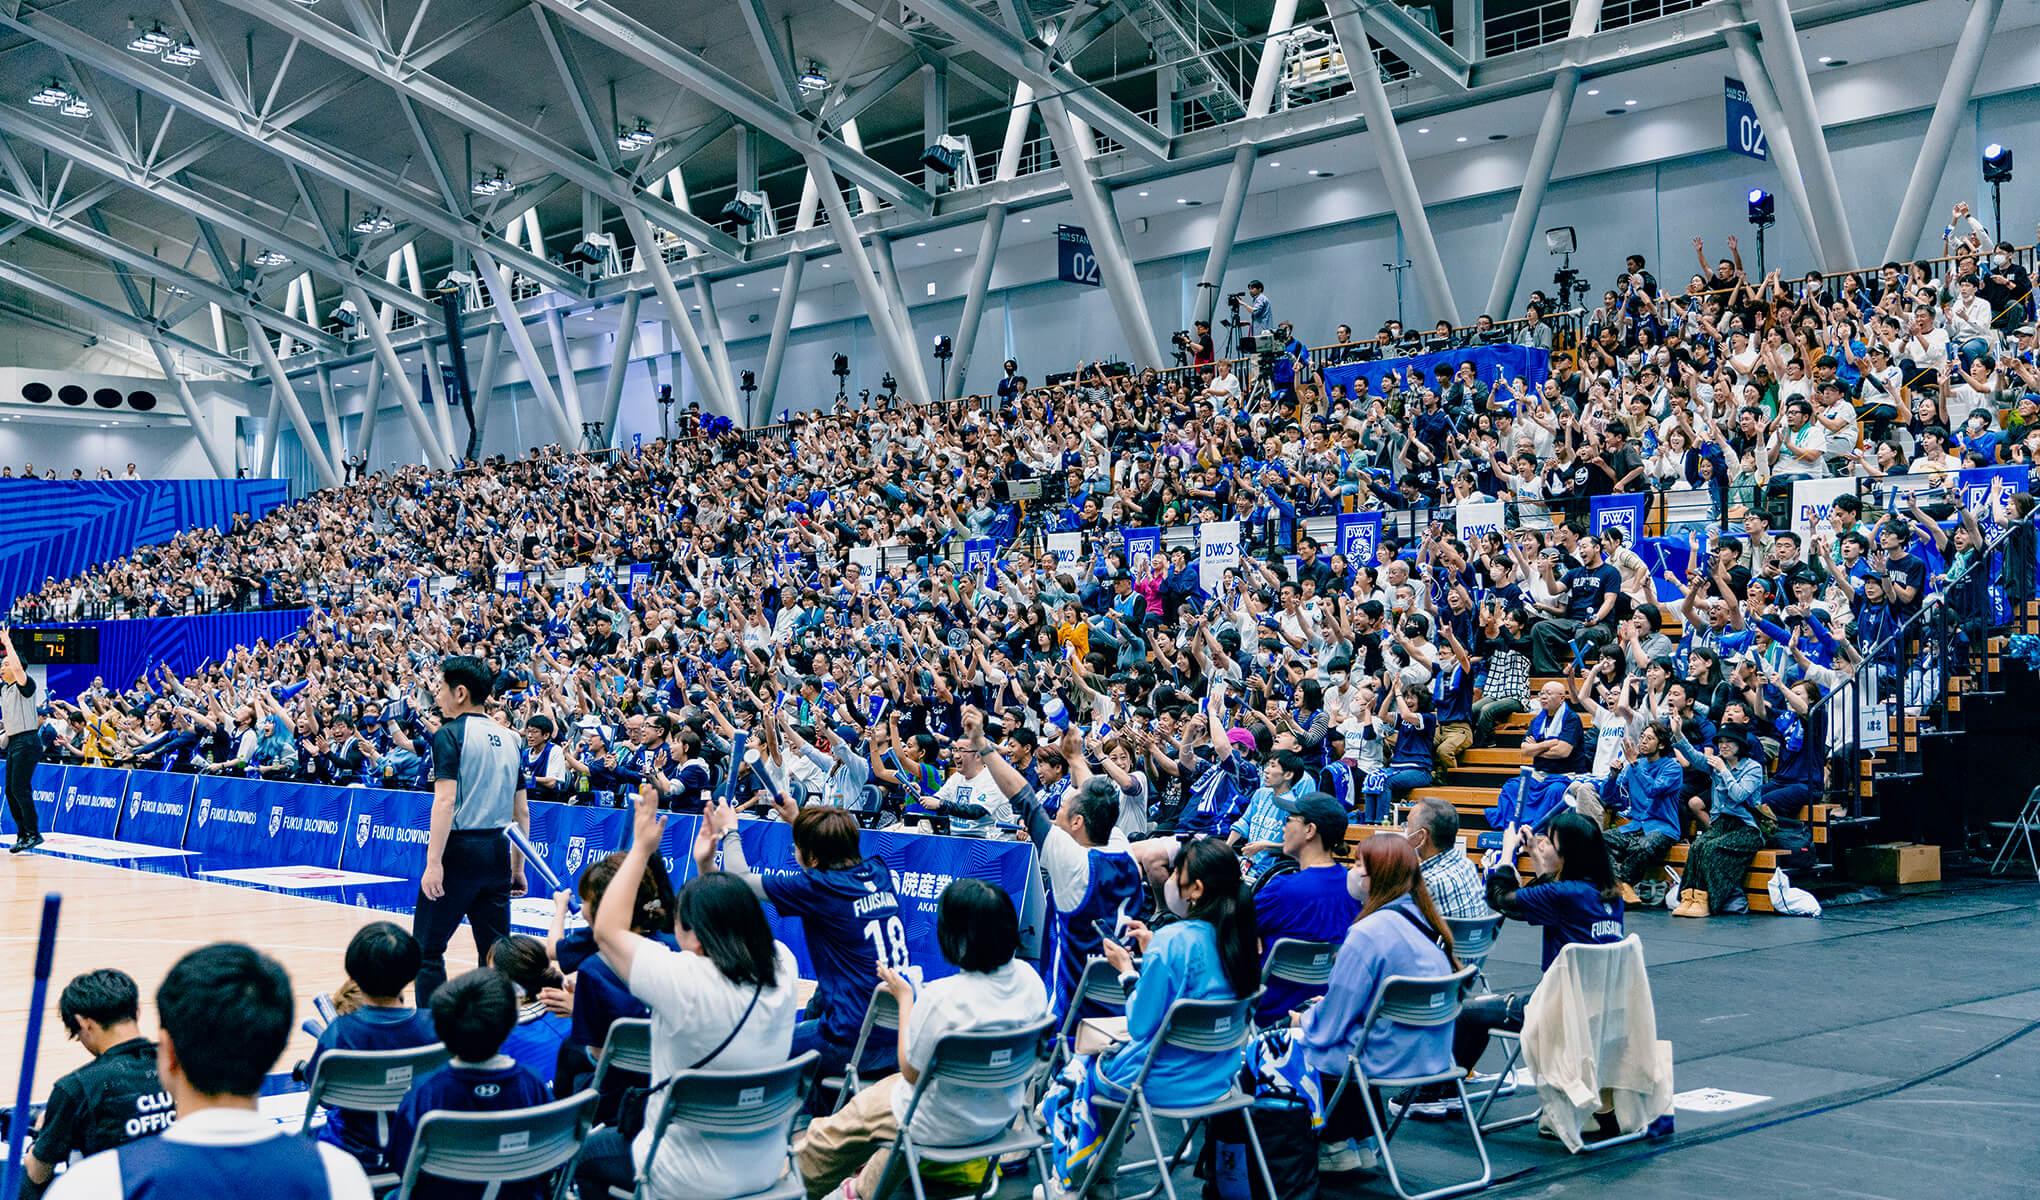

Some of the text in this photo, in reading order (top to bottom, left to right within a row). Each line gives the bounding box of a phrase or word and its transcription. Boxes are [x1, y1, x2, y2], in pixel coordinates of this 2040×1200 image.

[1740, 114, 1765, 156] 02
[1073, 252, 1098, 282] 02
[46, 644, 65, 657] 74
[282, 816, 303, 830] FUKUI
[371, 824, 395, 841] FUKUI
[901, 871, 959, 899] 暁産業
[863, 915, 910, 968] 18
